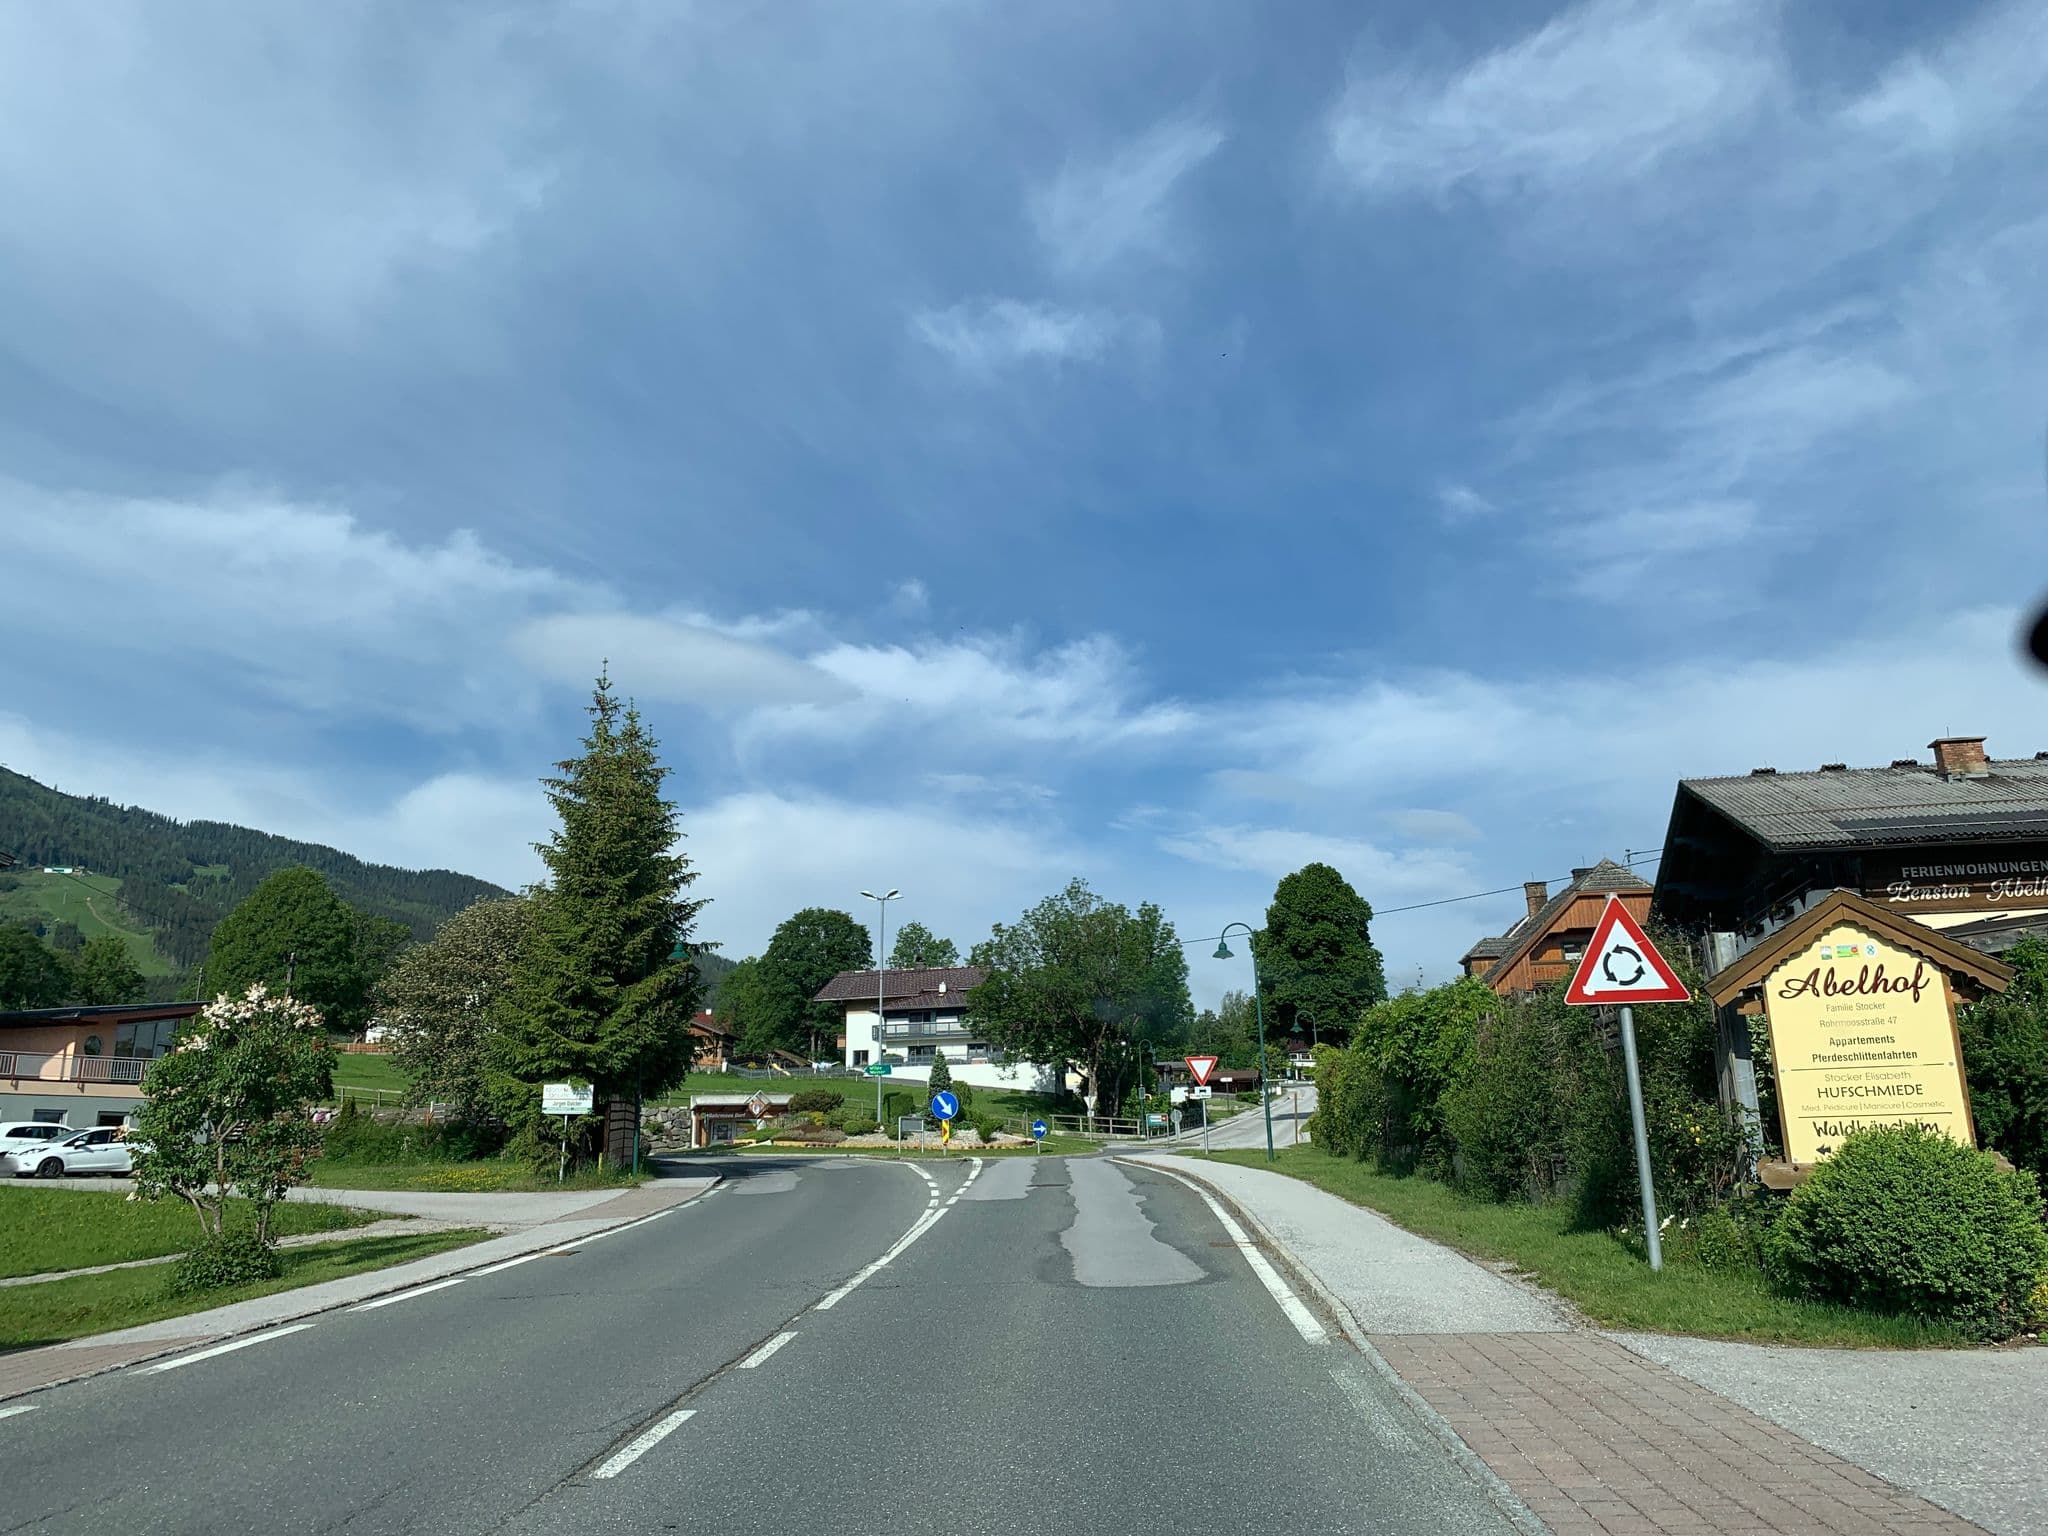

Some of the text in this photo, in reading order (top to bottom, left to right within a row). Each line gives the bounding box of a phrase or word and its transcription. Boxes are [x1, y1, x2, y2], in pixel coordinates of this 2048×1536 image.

[1902, 860, 2048, 878] FERIENWOHNUNGEN
[1887, 880, 1971, 902] Pension
[1778, 961, 1930, 1003] Abelhof
[1826, 1002, 1886, 1013] Familie Stocker
[1887, 1016, 1897, 1025] 47
[1829, 1034, 1895, 1047] Appartements
[1812, 1050, 1918, 1063] Pferdeschlittenfahrten
[1824, 1071, 1911, 1082] Stocker Elisabeth
[1817, 1084, 1924, 1098] HUFSCHMIEDE
